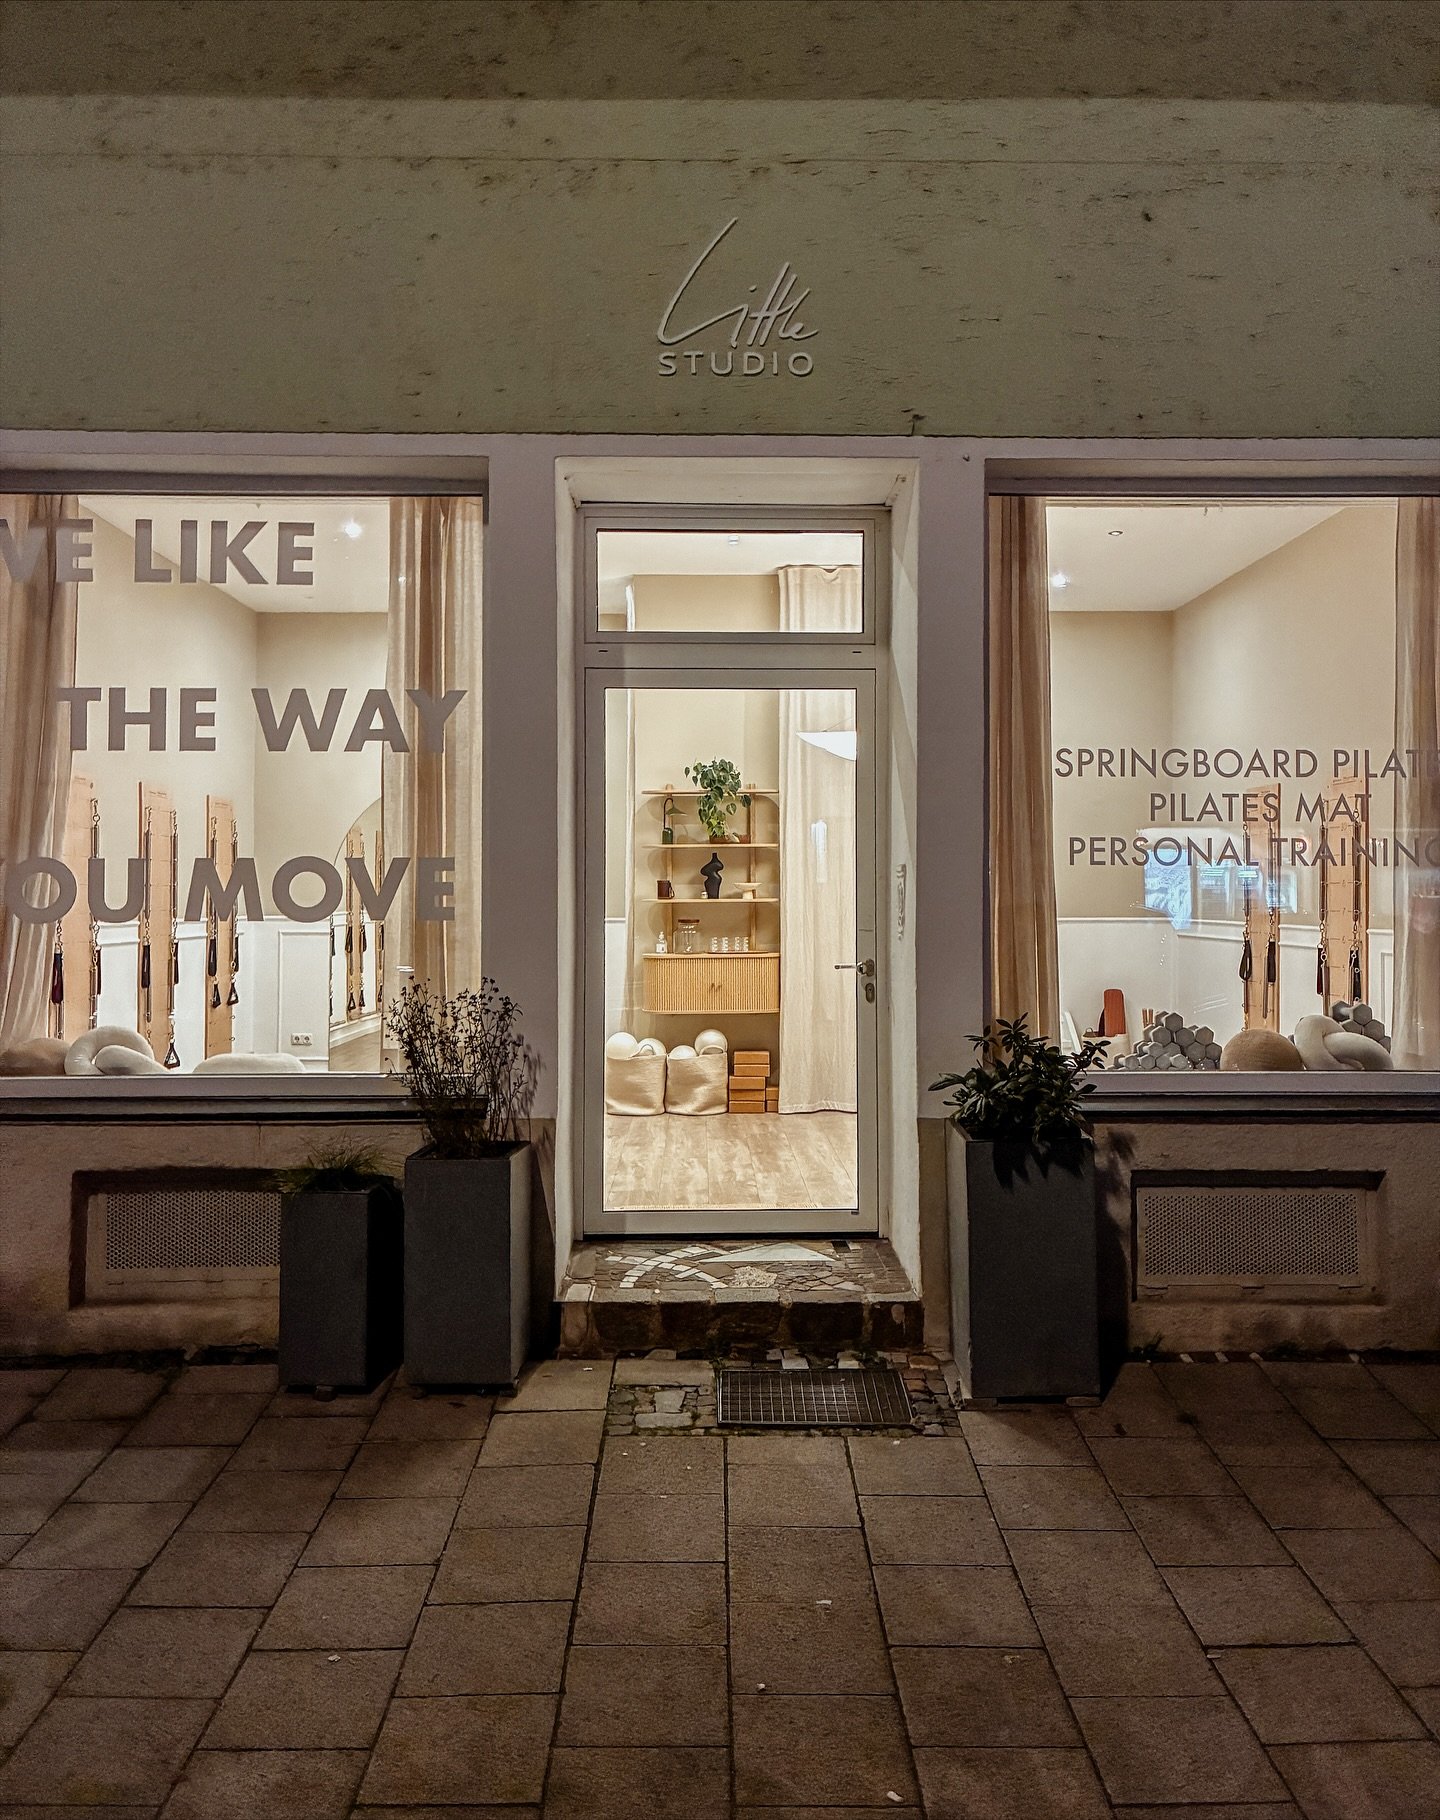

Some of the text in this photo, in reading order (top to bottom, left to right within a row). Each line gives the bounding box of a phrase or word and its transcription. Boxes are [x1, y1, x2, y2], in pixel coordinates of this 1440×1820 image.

[657, 217, 820, 349] Little
[658, 351, 815, 377] STUDIO
[134, 519, 315, 586] LIKE
[58, 687, 468, 753] THE WAY
[1054, 747, 1318, 778] SPRINGBOARD
[1150, 791, 1372, 823] PILATES MAT
[1069, 836, 1259, 867] PERSONAL
[0, 855, 456, 924] OU MOVE
